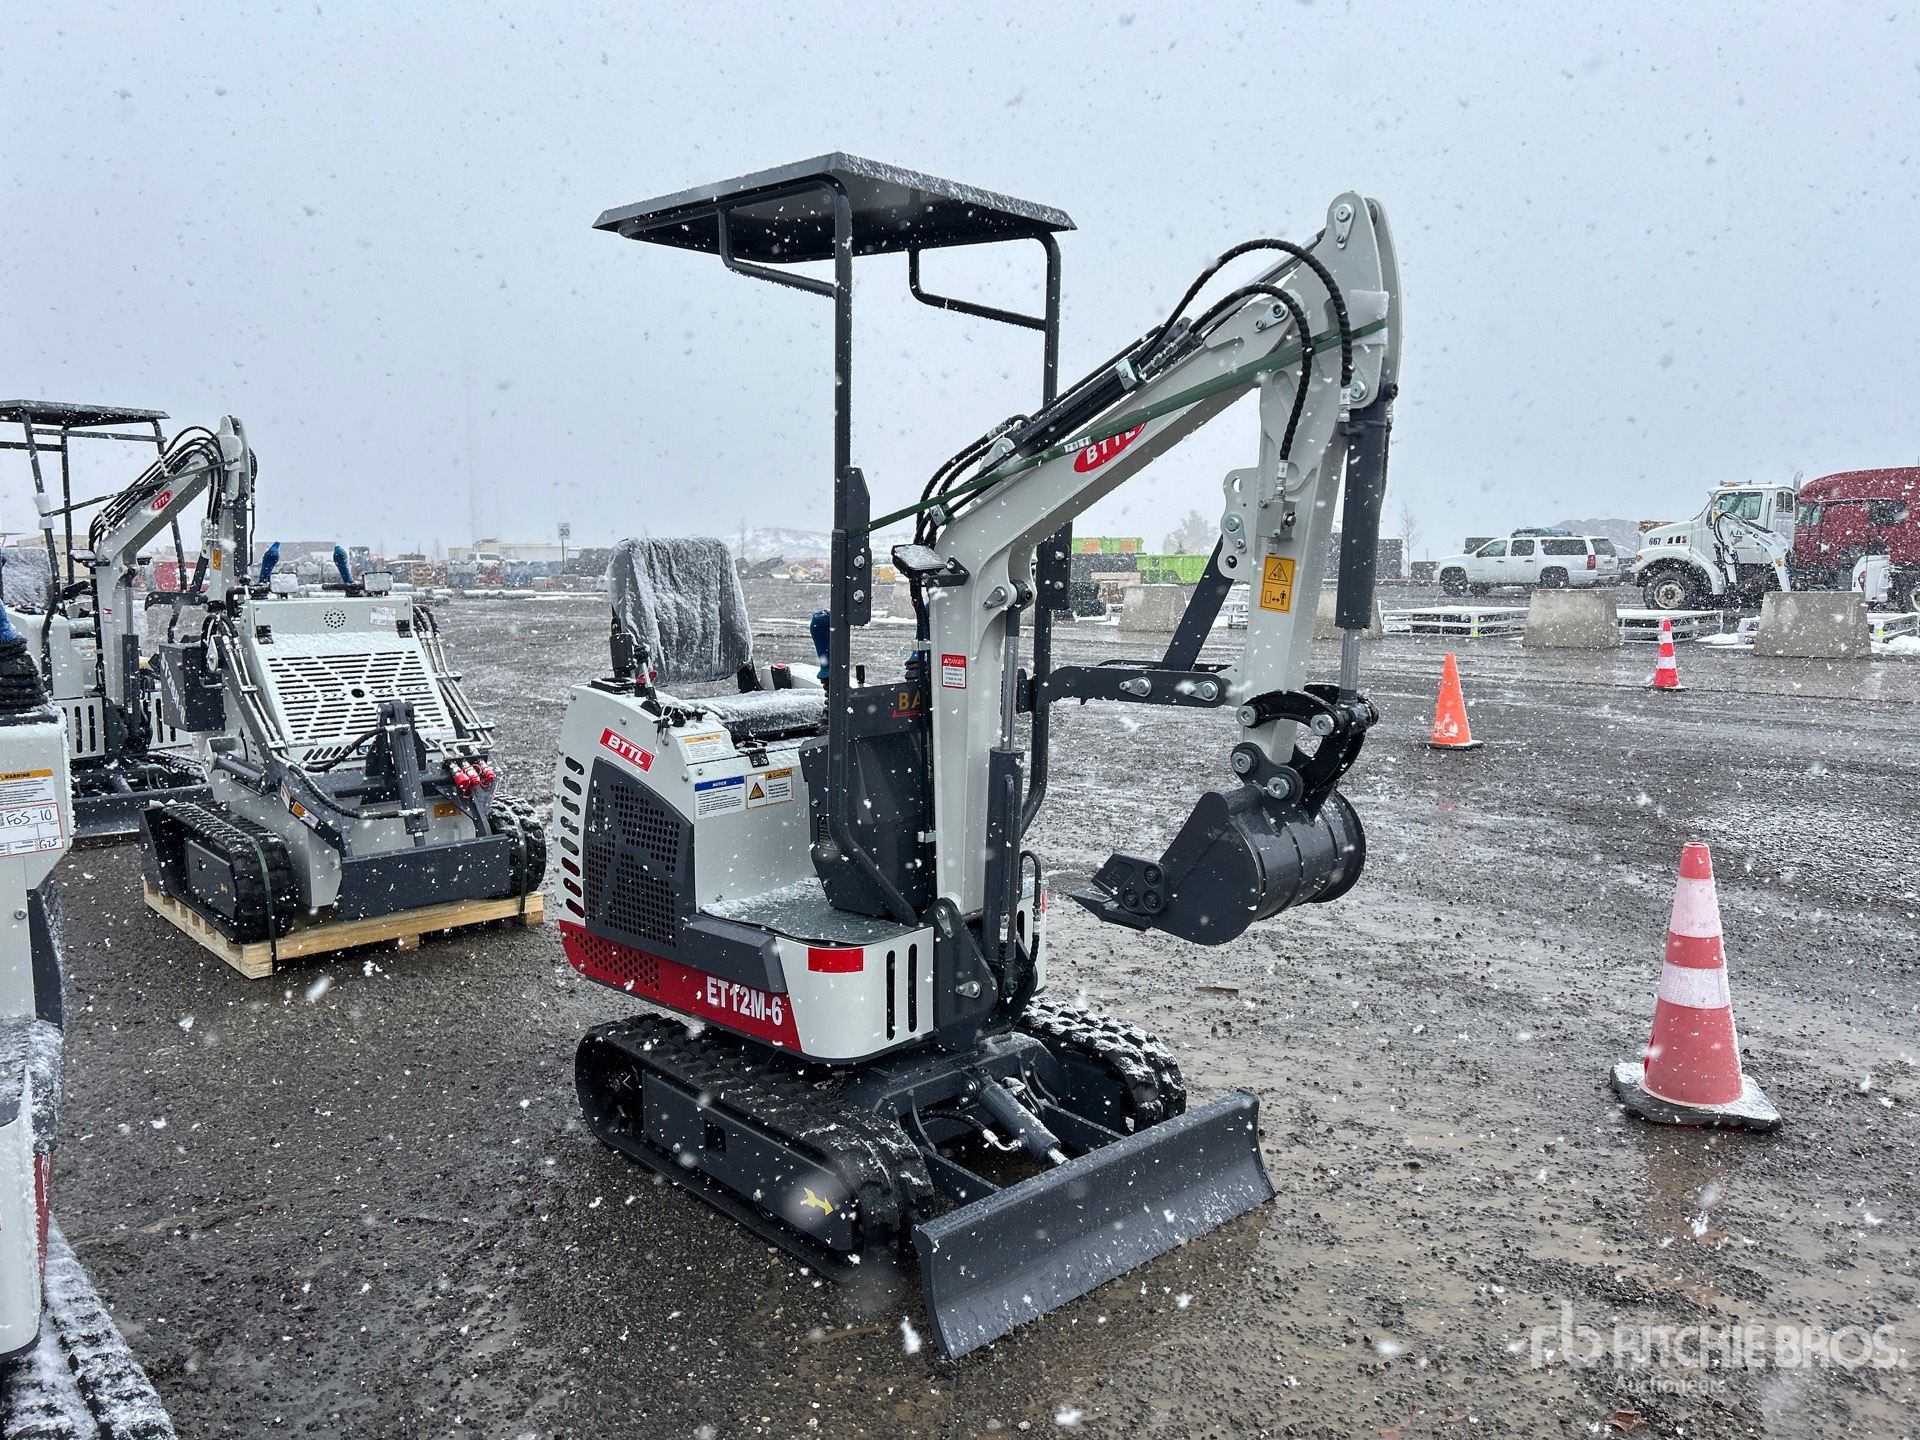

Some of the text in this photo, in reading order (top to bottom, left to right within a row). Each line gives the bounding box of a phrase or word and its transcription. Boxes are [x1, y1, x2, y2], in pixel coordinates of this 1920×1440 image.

[153, 494, 169, 510] BTTL
[1649, 538, 1661, 546] 667
[607, 734, 645, 766] BTTL
[4, 772, 31, 780] WARNING
[772, 770, 791, 778] CAUTION
[707, 976, 783, 1027] ET12M-6
